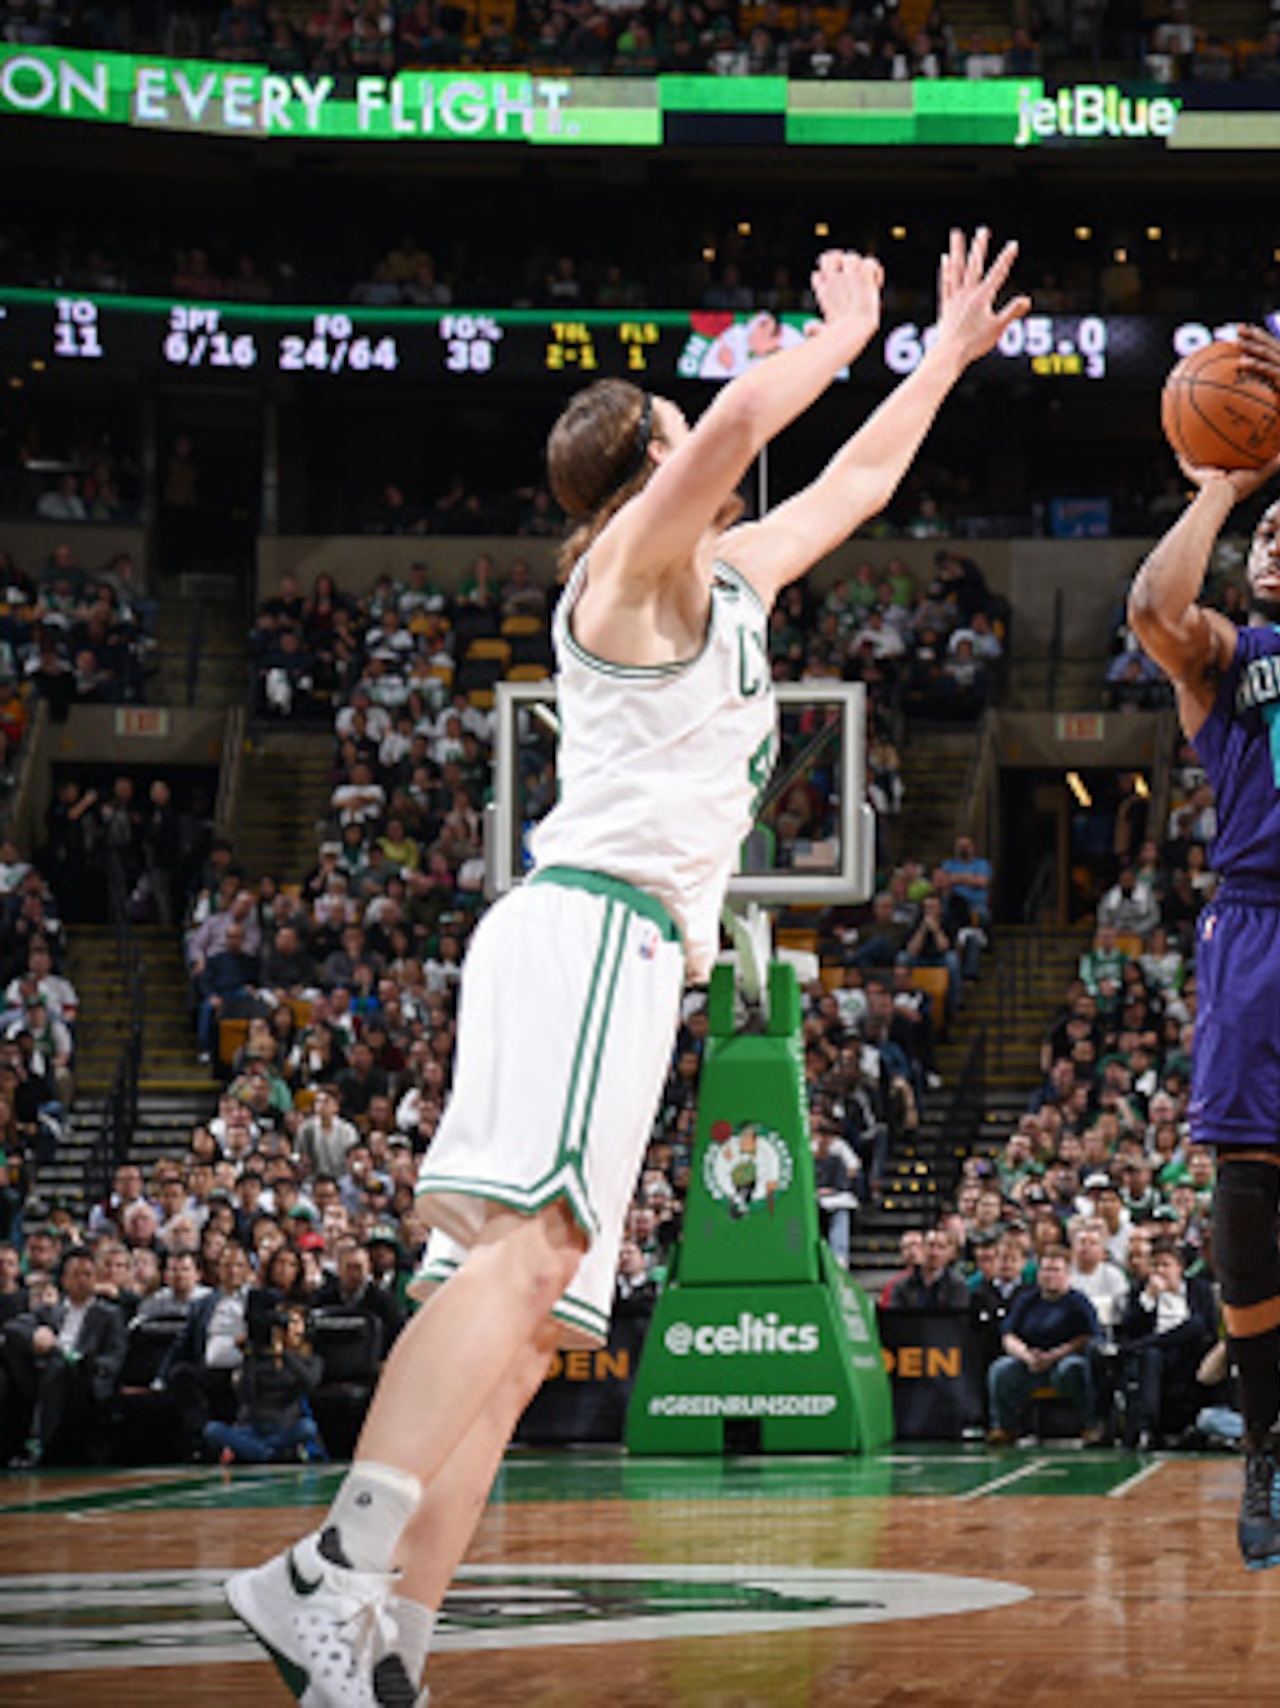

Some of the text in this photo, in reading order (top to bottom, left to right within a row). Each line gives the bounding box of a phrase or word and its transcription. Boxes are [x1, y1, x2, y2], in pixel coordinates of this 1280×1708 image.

[0, 56, 581, 136] ON EVERY FLIGHT.
[1015, 83, 1178, 145] jetBlue
[55, 298, 98, 323] TO
[54, 323, 102, 358] 11
[164, 332, 256, 367] 6/16
[279, 335, 398, 373] 24/64
[664, 1312, 820, 1356] @celtics
[648, 1393, 838, 1417] #GREENRUNSDEEP
